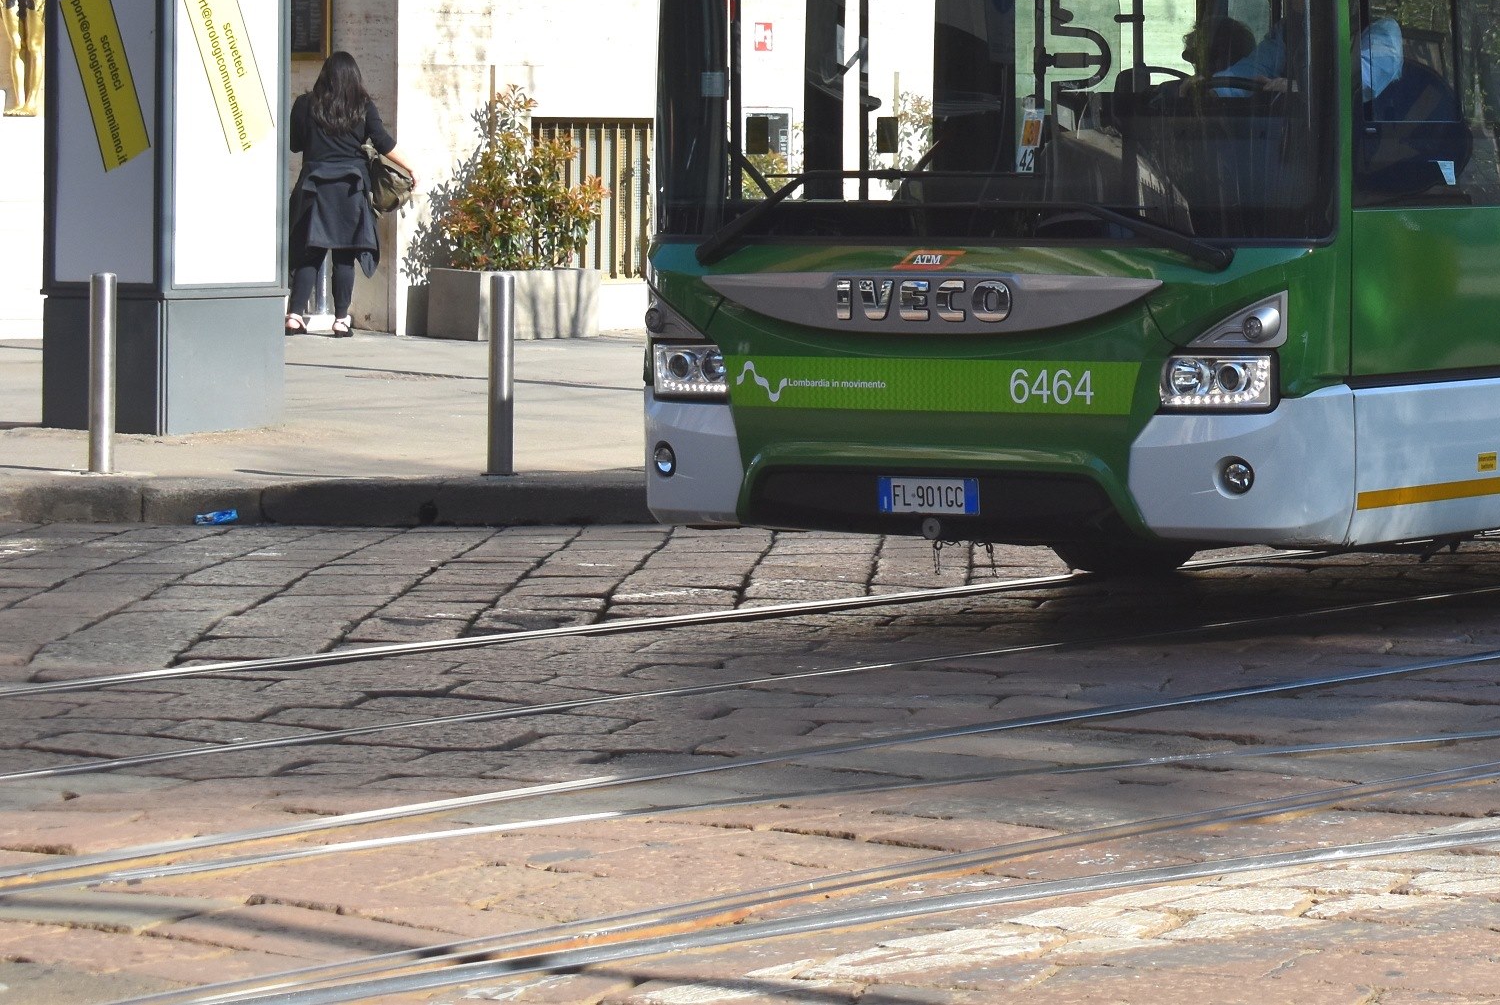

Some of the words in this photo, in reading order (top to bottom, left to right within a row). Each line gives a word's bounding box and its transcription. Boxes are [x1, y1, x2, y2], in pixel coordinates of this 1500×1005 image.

[100, 34, 125, 91] scriveteci
[222, 22, 247, 78] scriveteci
[1019, 149, 1035, 171] 42
[913, 254, 942, 265] ATM
[836, 279, 1013, 323] IVECO
[788, 378, 830, 387] Lombardia
[832, 379, 839, 388] in
[841, 380, 886, 389] movimento
[1009, 368, 1094, 405] 6464
